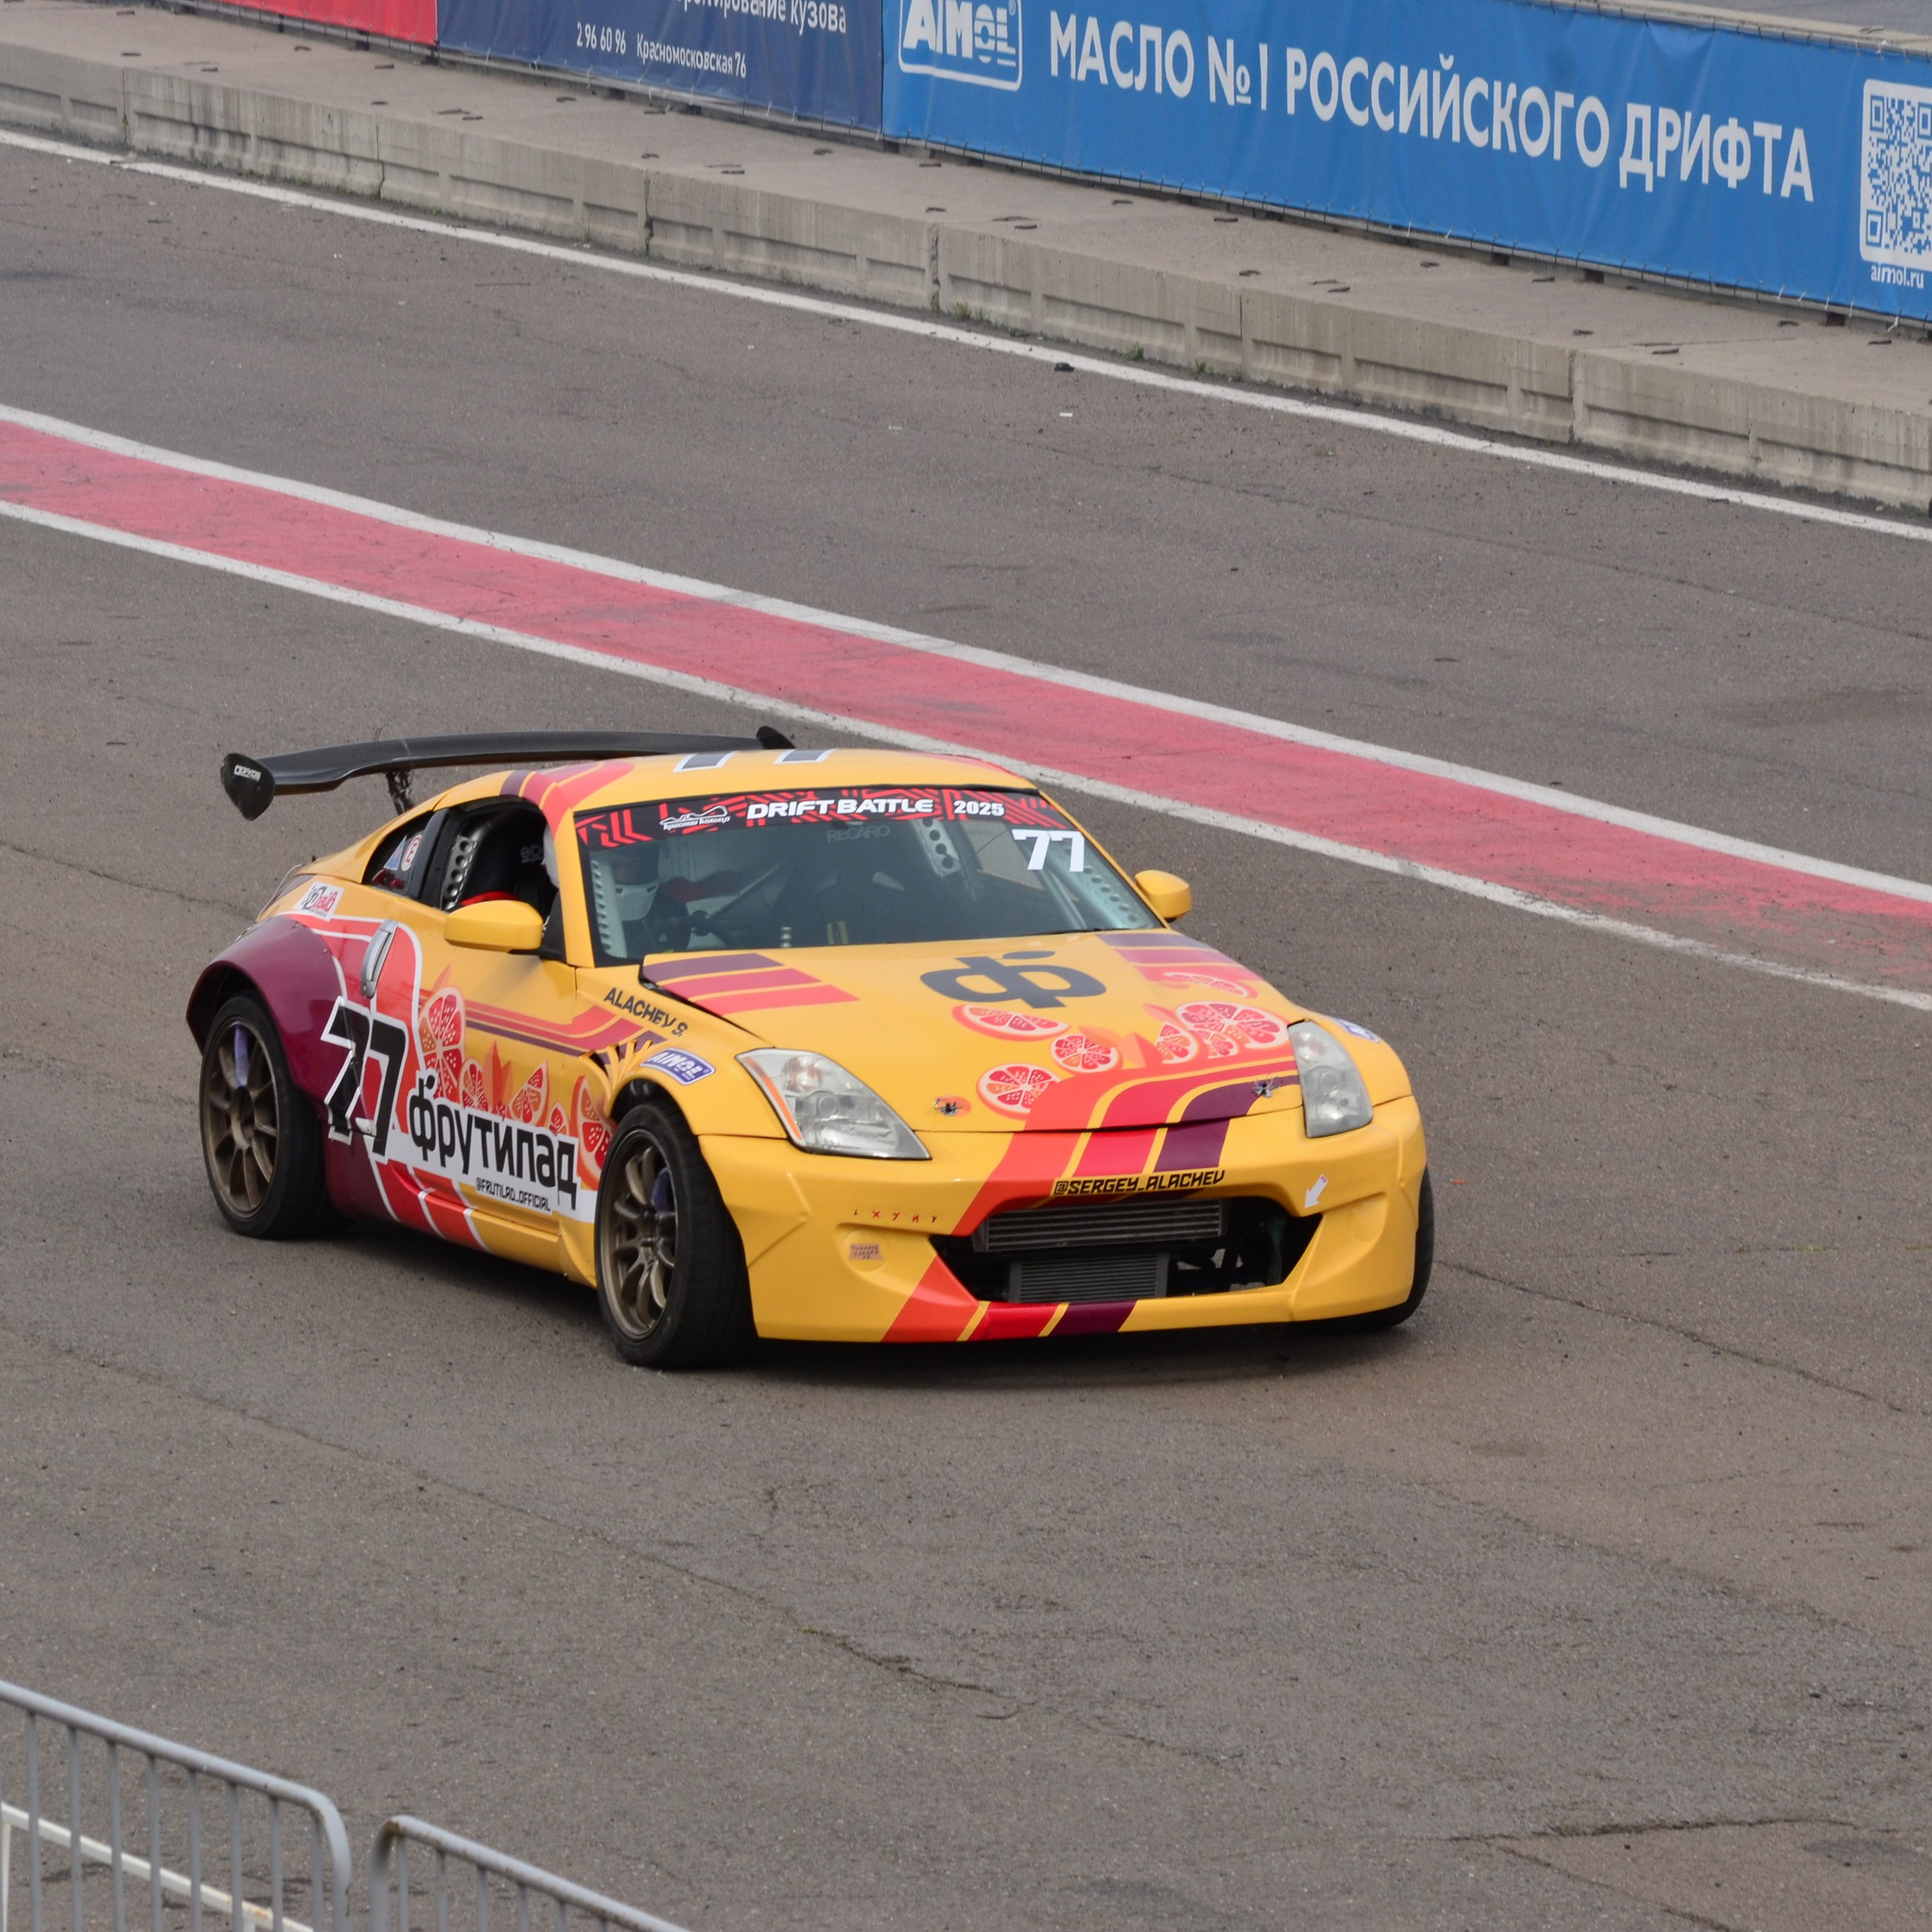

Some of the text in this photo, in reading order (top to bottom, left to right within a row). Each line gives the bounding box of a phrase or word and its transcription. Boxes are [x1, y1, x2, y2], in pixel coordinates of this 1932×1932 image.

[790, 0, 847, 35] кузова
[636, 33, 746, 78] Красномосковская 76
[1050, 11, 1195, 99] МАСЛО
[1286, 46, 1611, 169] РОССИЙСКОГО
[1619, 102, 1814, 204] ДРИФТА
[1870, 262, 1924, 289] aimol.ru
[746, 798, 934, 820] DRIFT BATTLE
[953, 800, 1006, 817] 2025
[827, 825, 891, 843] RECARO
[1012, 829, 1085, 872] 77
[604, 986, 677, 1028] ALACHEV
[321, 995, 409, 1166] 77
[647, 1051, 704, 1081] AIMOL
[1054, 1170, 1226, 1195] @SERGEY_ALACHEV
